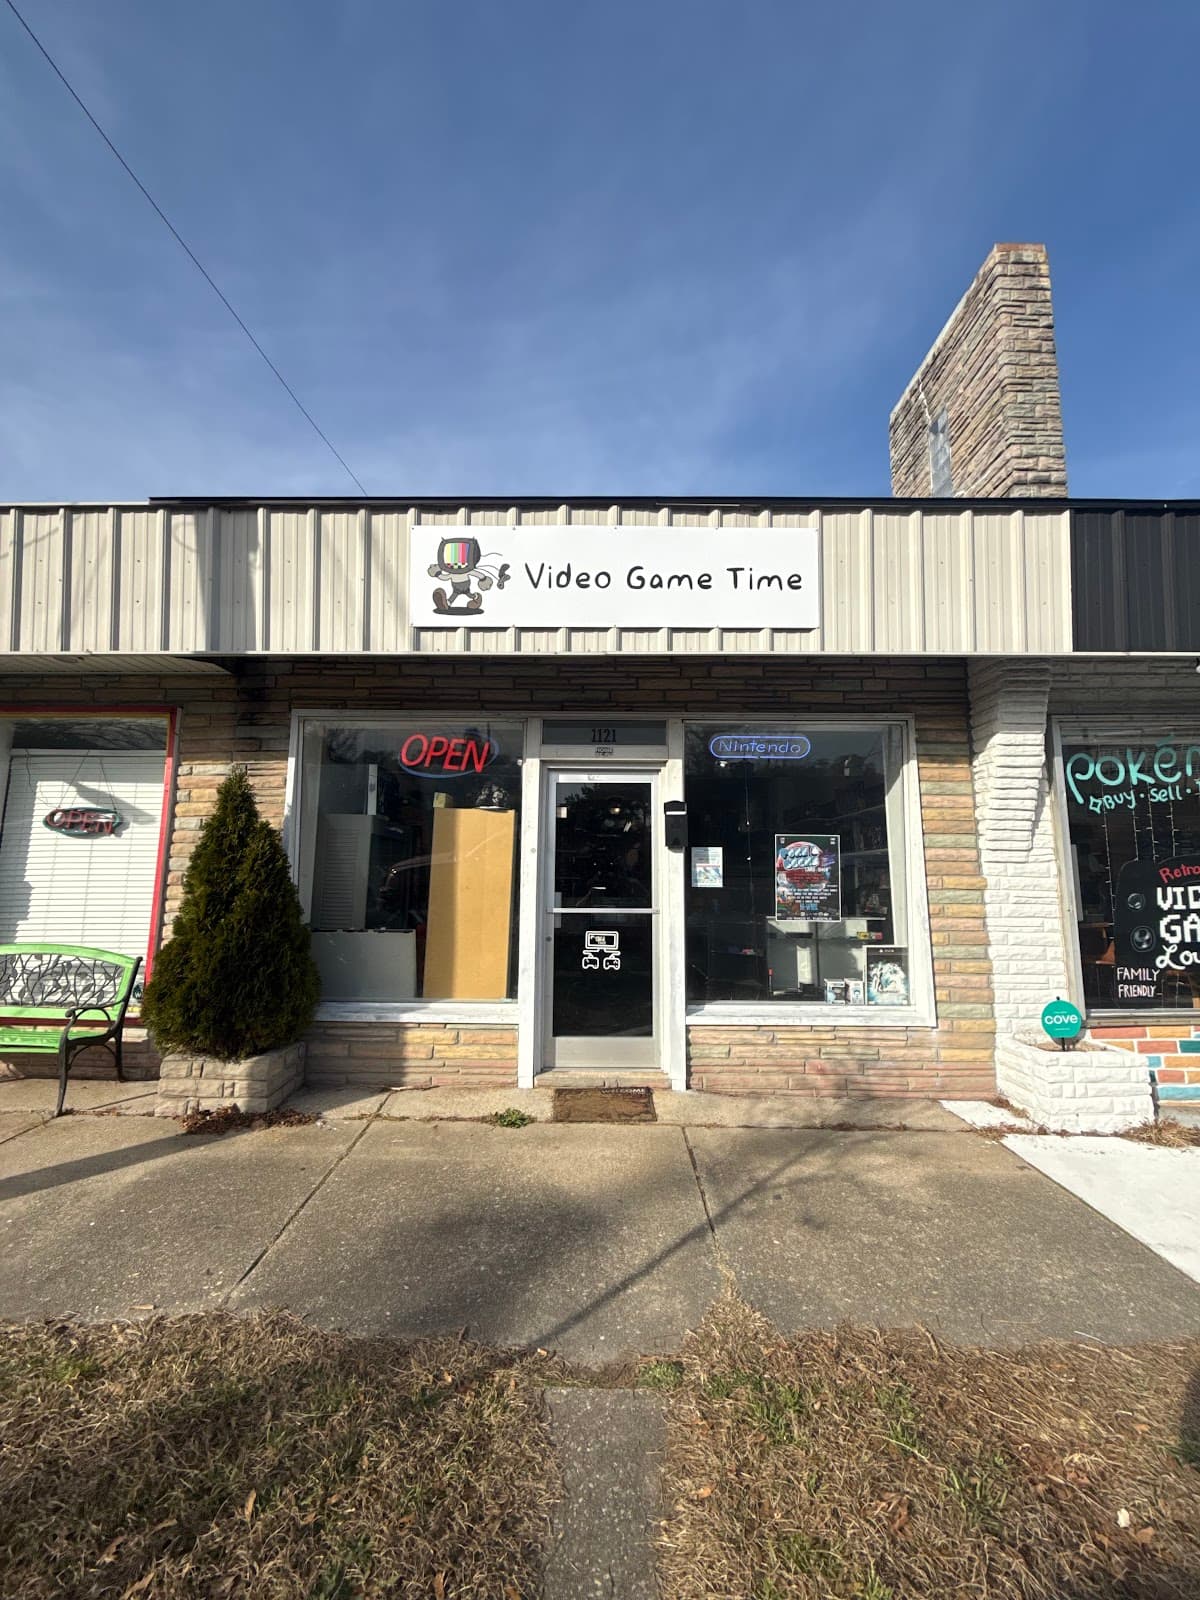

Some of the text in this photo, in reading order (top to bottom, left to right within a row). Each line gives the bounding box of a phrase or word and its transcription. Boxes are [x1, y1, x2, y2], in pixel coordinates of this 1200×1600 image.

[524, 562, 803, 592] Video Game Time
[591, 728, 617, 743] 1121
[401, 733, 490, 773] OPEN
[719, 740, 801, 753] Nintendo
[46, 808, 115, 835] OPEN
[1159, 863, 1200, 884] Retro
[1116, 966, 1160, 982] FAMILY
[1117, 984, 1156, 998] FRIENDLY
[1044, 1014, 1079, 1025] cove
